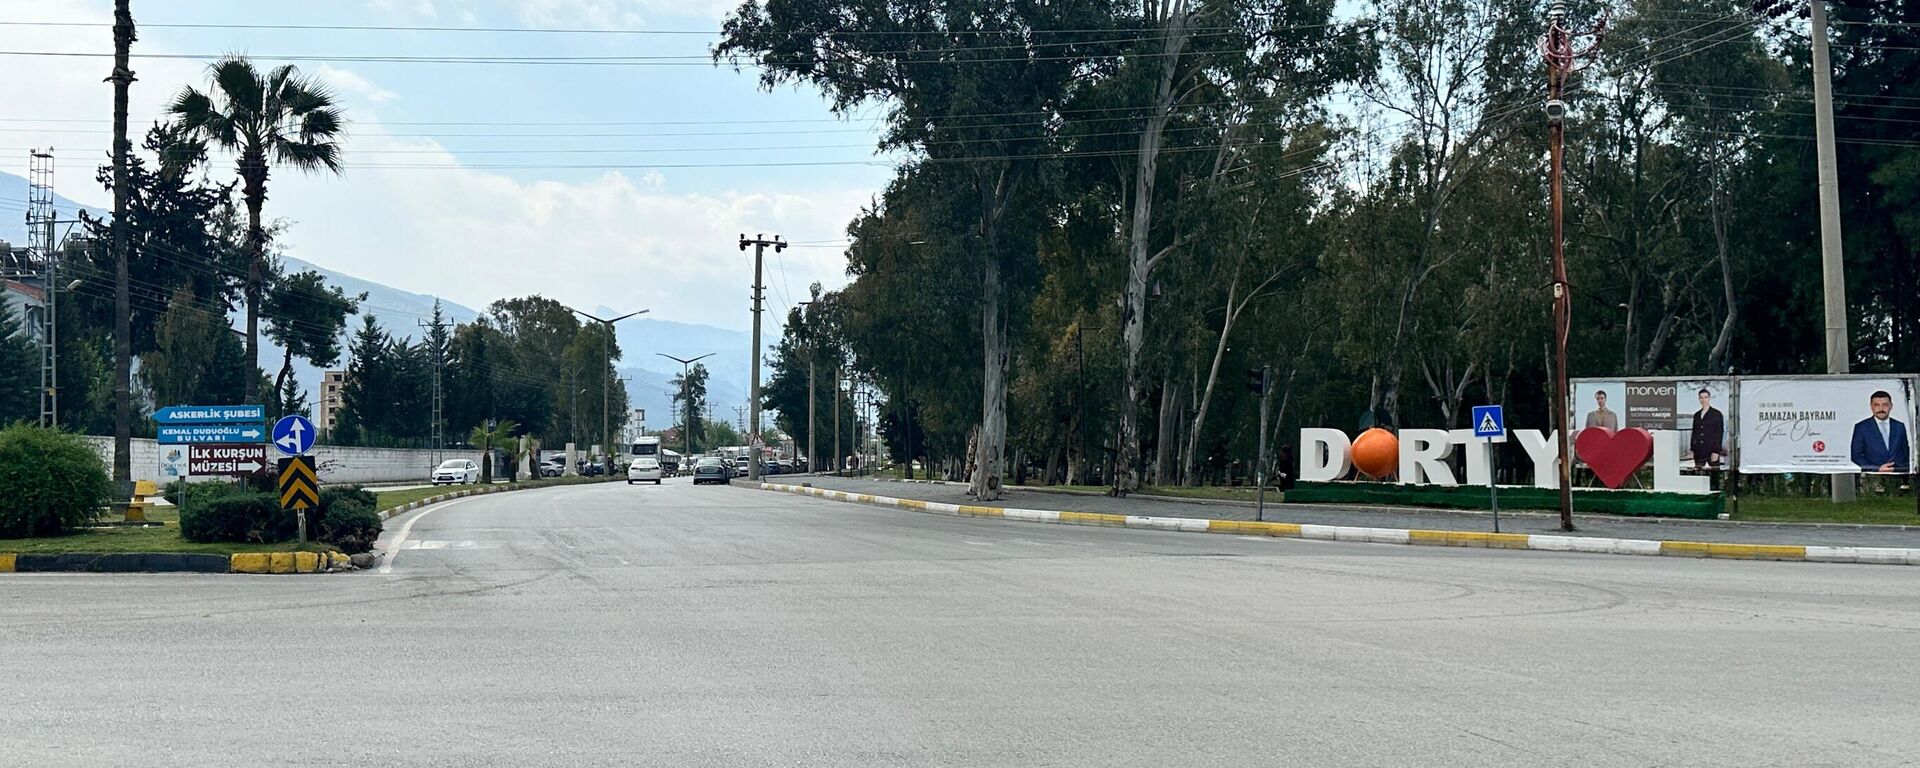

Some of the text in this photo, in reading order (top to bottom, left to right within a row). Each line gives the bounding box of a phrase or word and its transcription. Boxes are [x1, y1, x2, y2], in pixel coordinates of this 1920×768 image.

[1626, 386, 1676, 396] morven
[169, 408, 261, 420] ASKERLİK ŞUBESİ
[1759, 411, 1836, 421] RAMAZAN BAYRAMI
[193, 427, 240, 435] DUDUOĞLU
[191, 446, 264, 461] İLK KURŞUN
[1300, 426, 1710, 492] DRTYL
[191, 459, 237, 472] MÜZESİ
